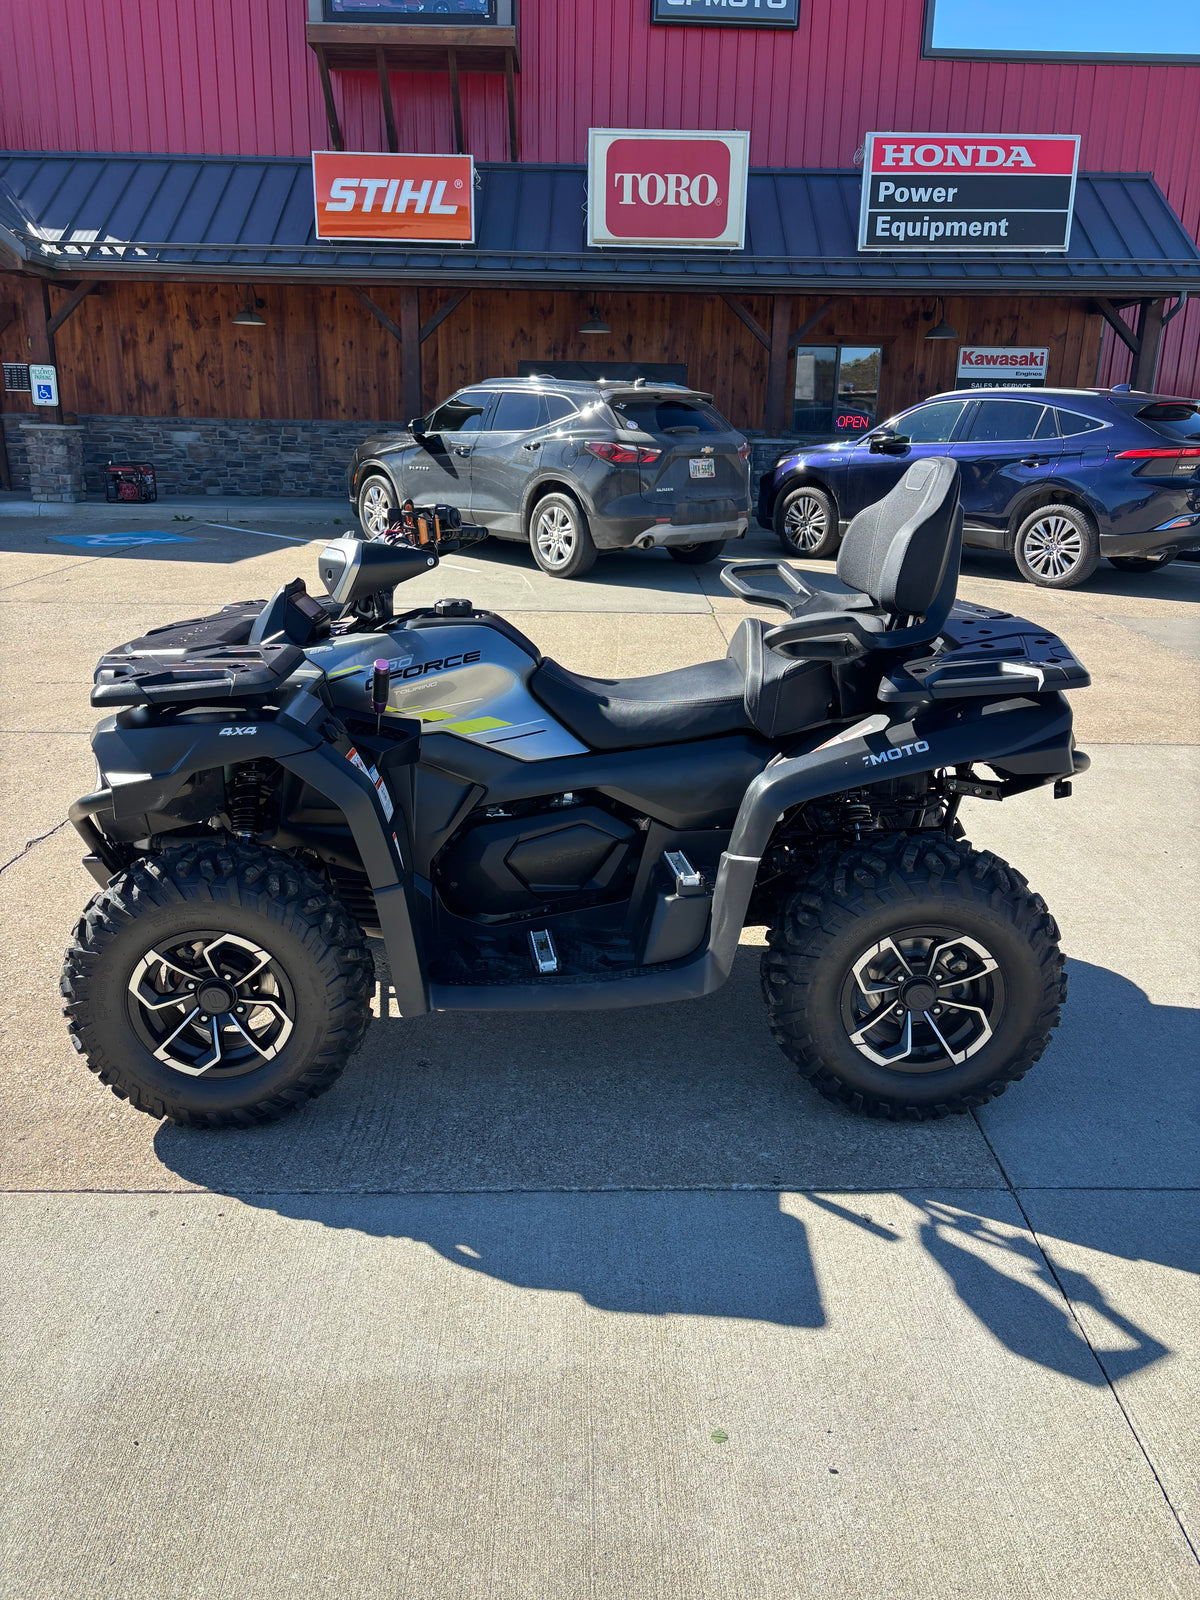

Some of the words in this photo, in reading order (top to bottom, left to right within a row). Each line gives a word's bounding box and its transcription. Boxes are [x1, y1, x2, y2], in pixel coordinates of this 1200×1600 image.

[881, 145, 1036, 167] HONDA
[325, 178, 458, 214] STIHL
[614, 172, 718, 206] TORO
[878, 181, 958, 203] Power
[875, 216, 1009, 241] Equipment
[961, 351, 1045, 366] Kawasaki
[837, 415, 869, 428] OPEN
[369, 656, 413, 677] 00
